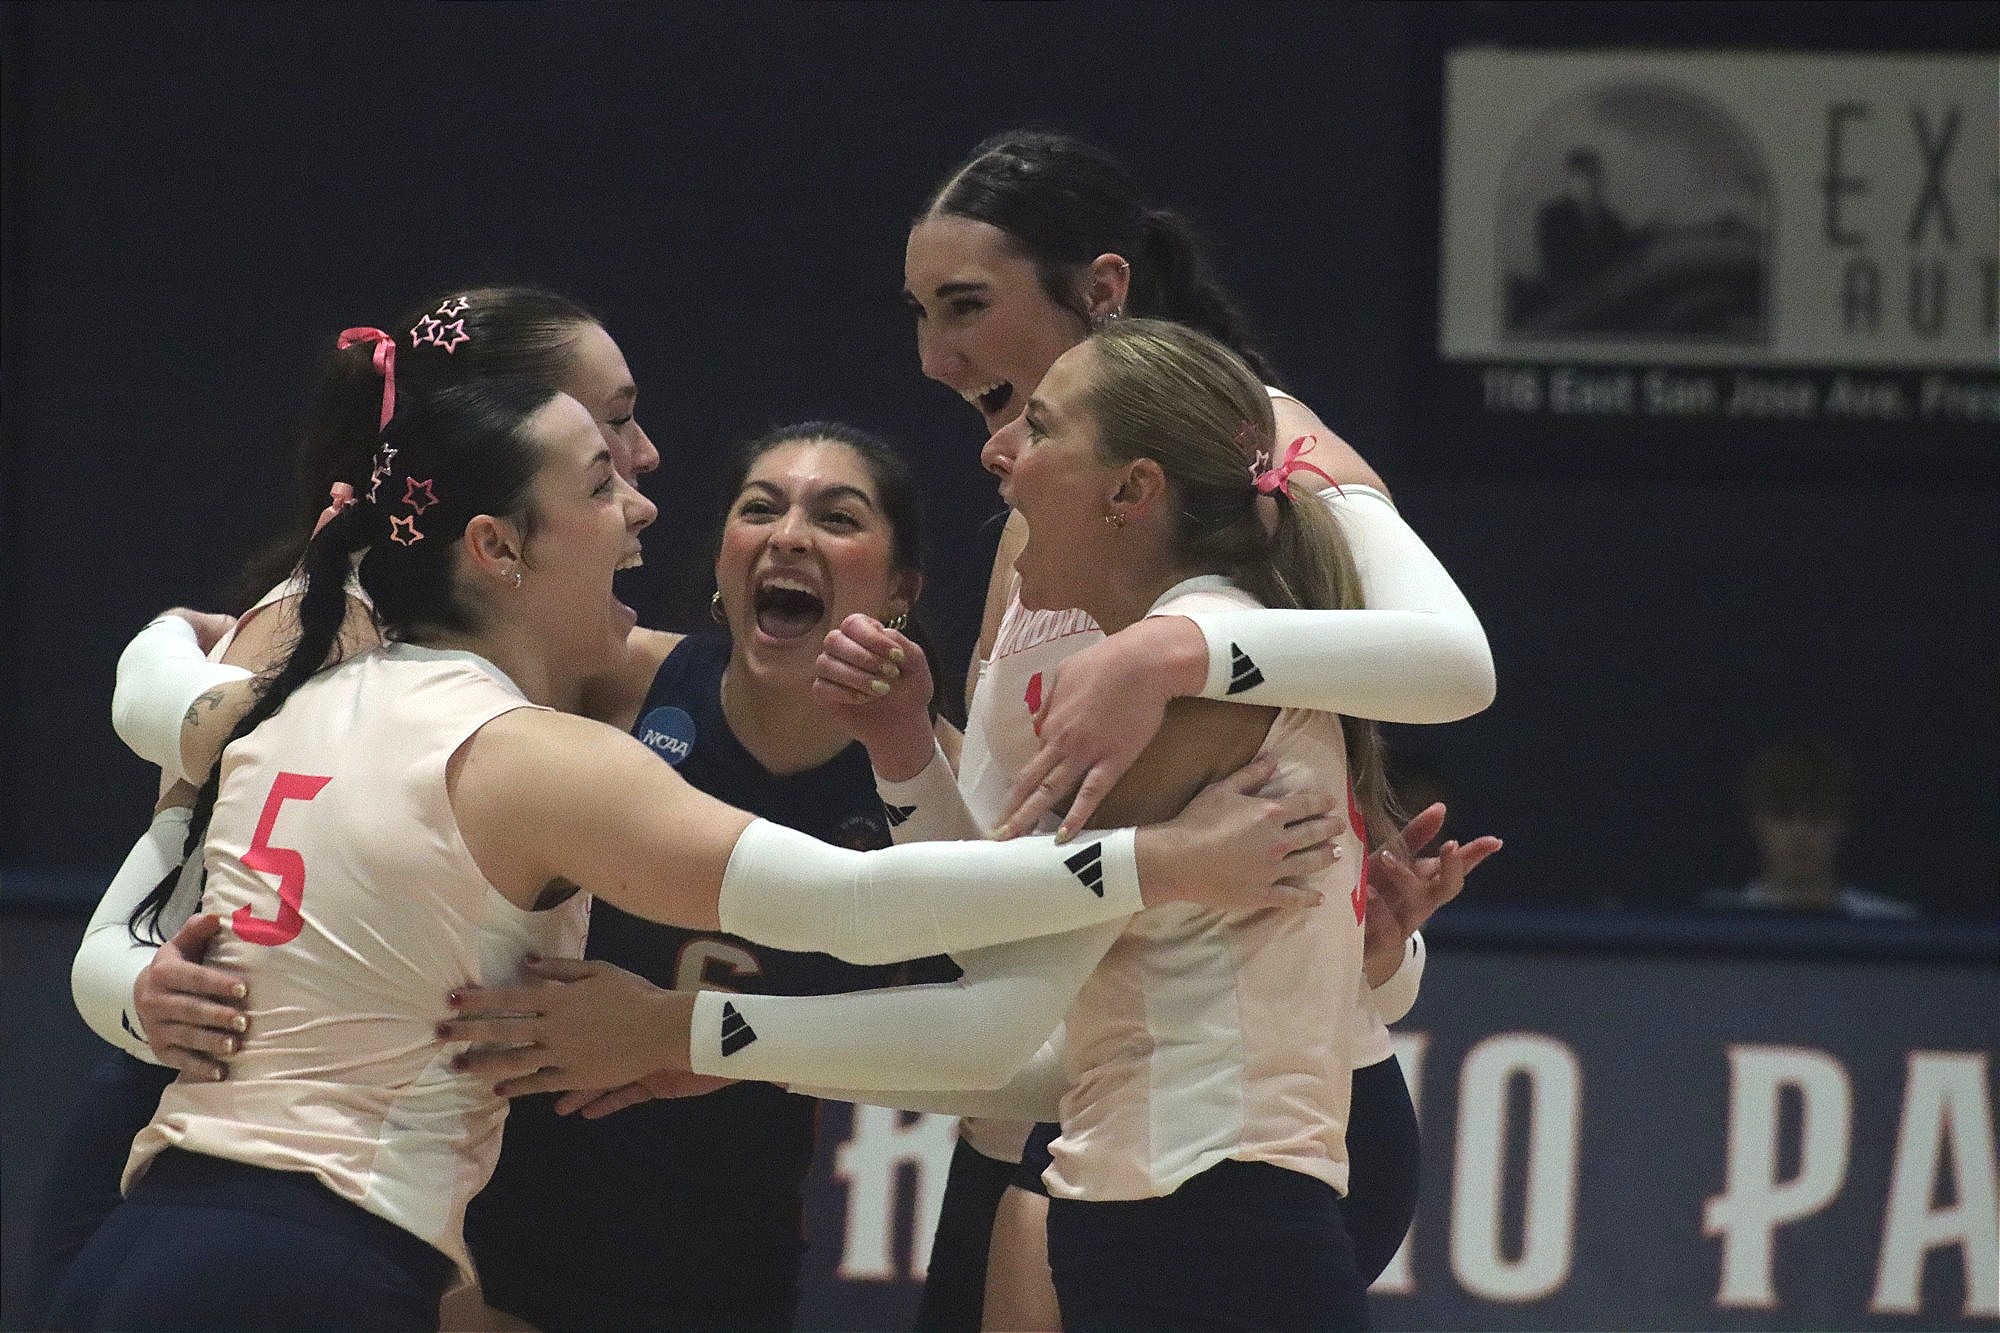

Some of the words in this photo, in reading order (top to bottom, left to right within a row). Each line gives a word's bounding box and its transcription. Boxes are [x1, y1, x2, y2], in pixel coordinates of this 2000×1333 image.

[1549, 368, 1634, 413] East
[1643, 369, 1717, 414] San
[1727, 372, 1816, 418] Jose
[642, 729, 689, 758] NCAA
[232, 772, 334, 946] 5
[1702, 1044, 2000, 1320] PA
